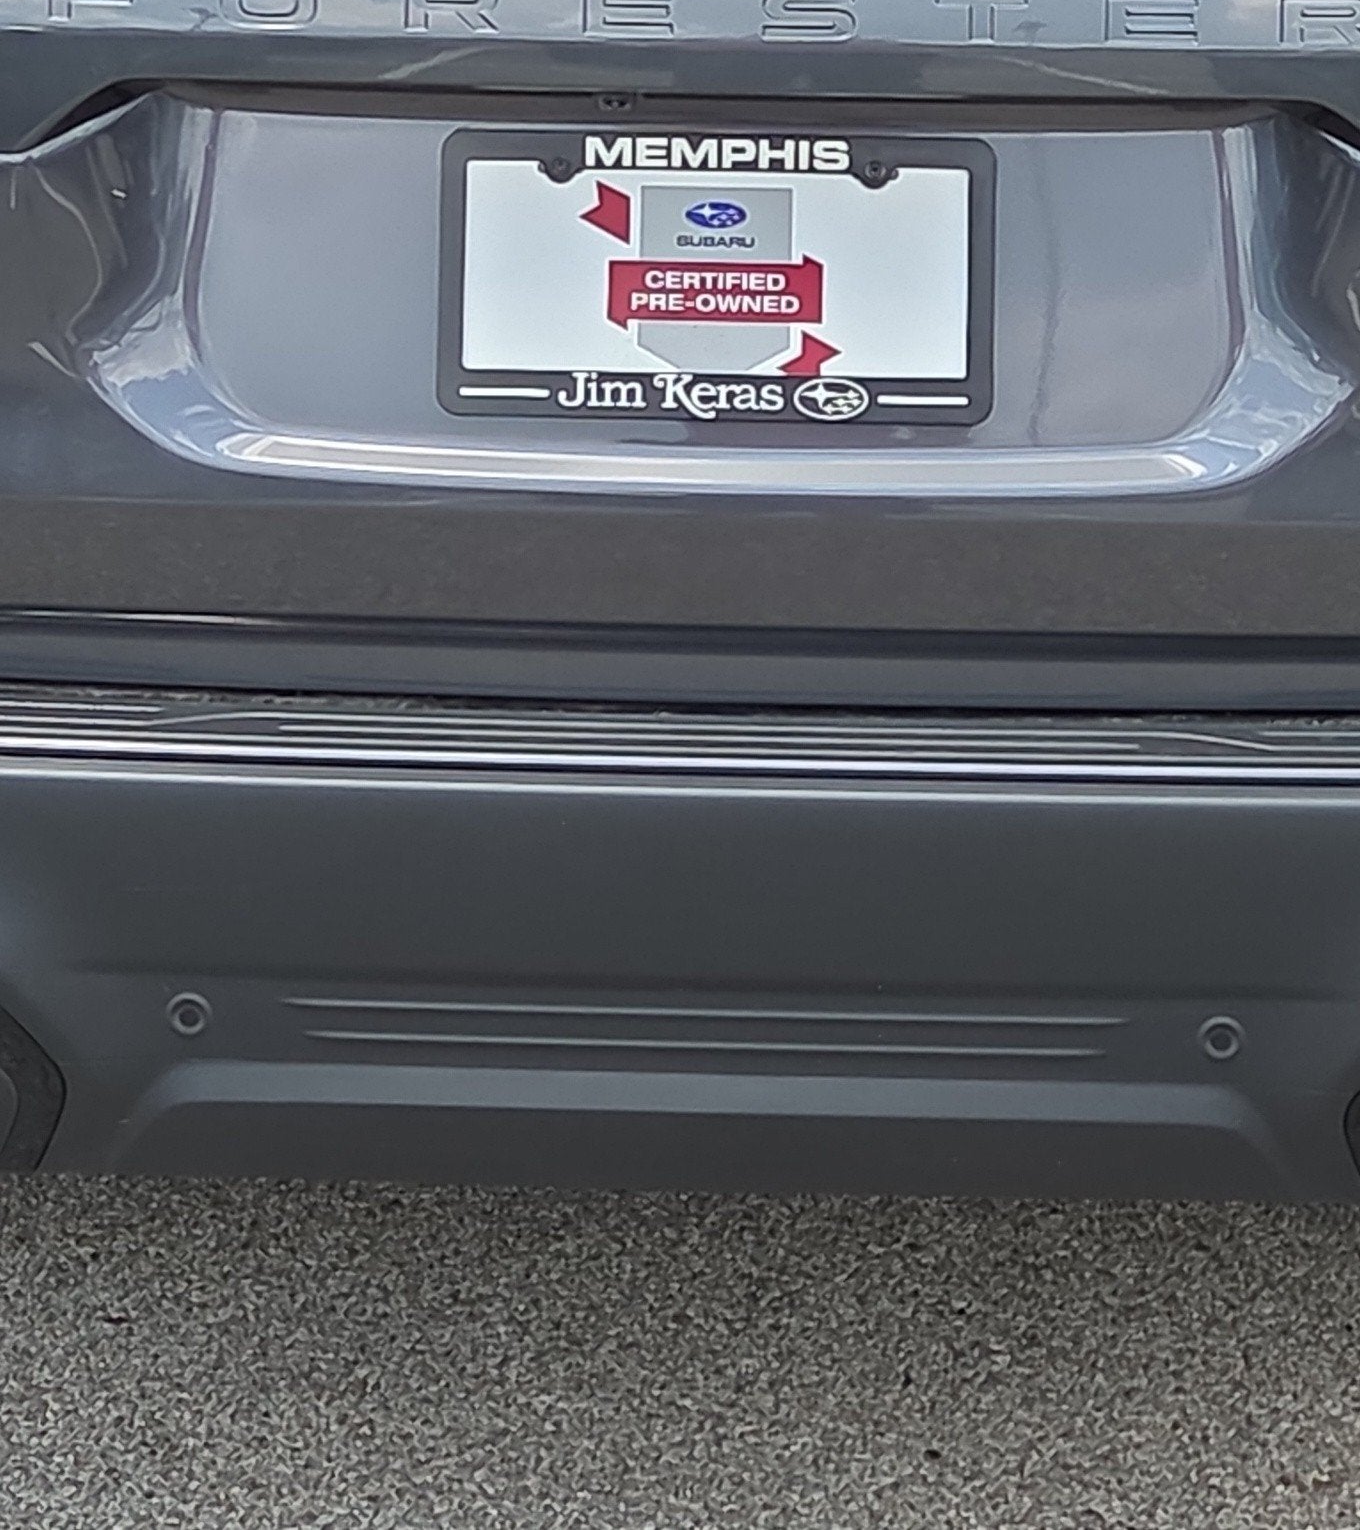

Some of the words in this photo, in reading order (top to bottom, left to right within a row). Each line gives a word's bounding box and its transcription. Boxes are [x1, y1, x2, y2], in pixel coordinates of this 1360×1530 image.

[584, 135, 852, 172] MEMPHIS
[675, 232, 756, 250] SUBARU
[643, 269, 787, 293] CERTIFIED
[630, 291, 801, 315] PRE-OWNED
[556, 372, 647, 410] Jim
[653, 372, 786, 421] Keras
